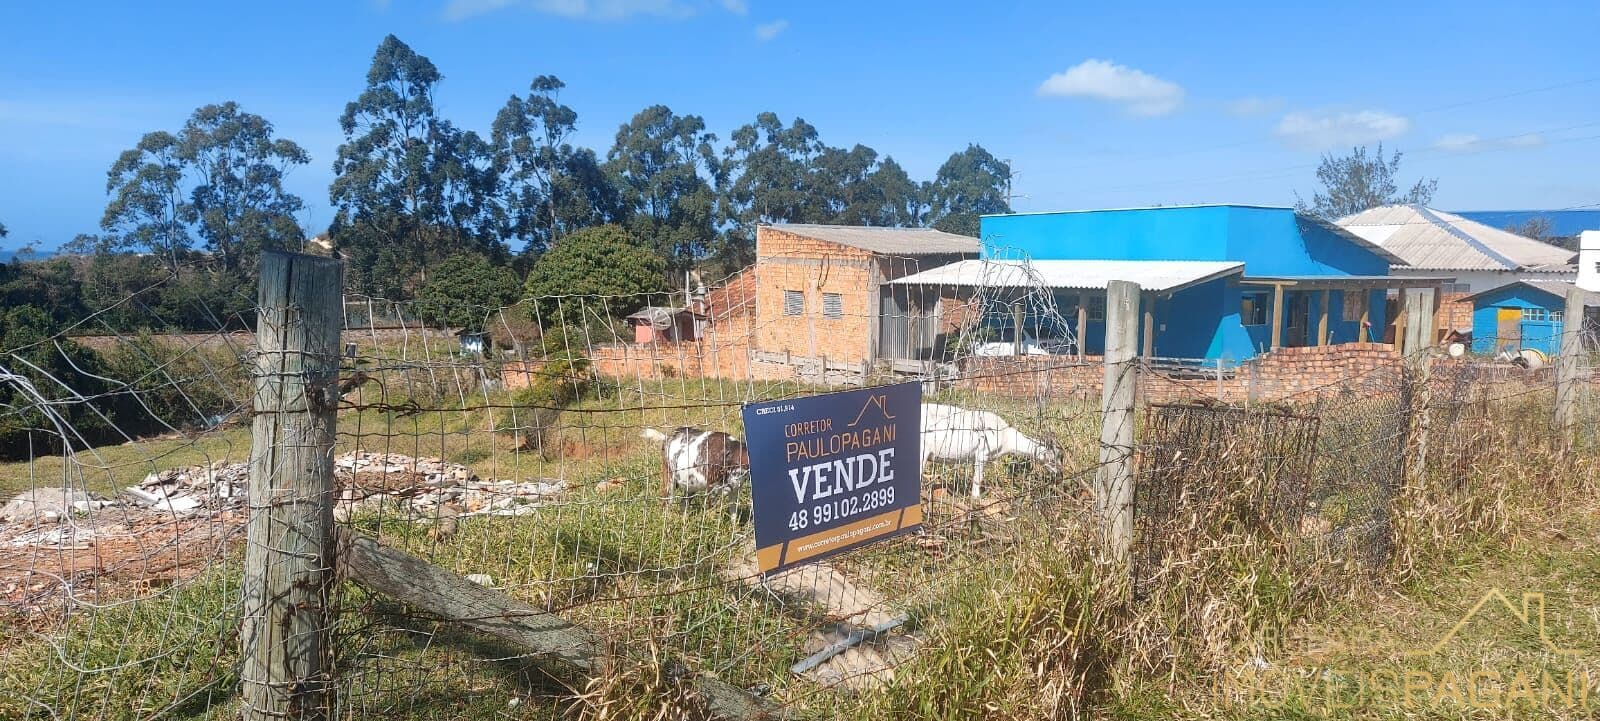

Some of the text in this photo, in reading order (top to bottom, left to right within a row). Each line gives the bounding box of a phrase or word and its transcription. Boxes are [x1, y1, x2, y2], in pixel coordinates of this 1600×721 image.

[784, 418, 833, 438] CORRETOR
[786, 423, 896, 464] PAULOPAGANI
[788, 447, 895, 504] VENDE
[788, 486, 895, 532] 48 99102.2899
